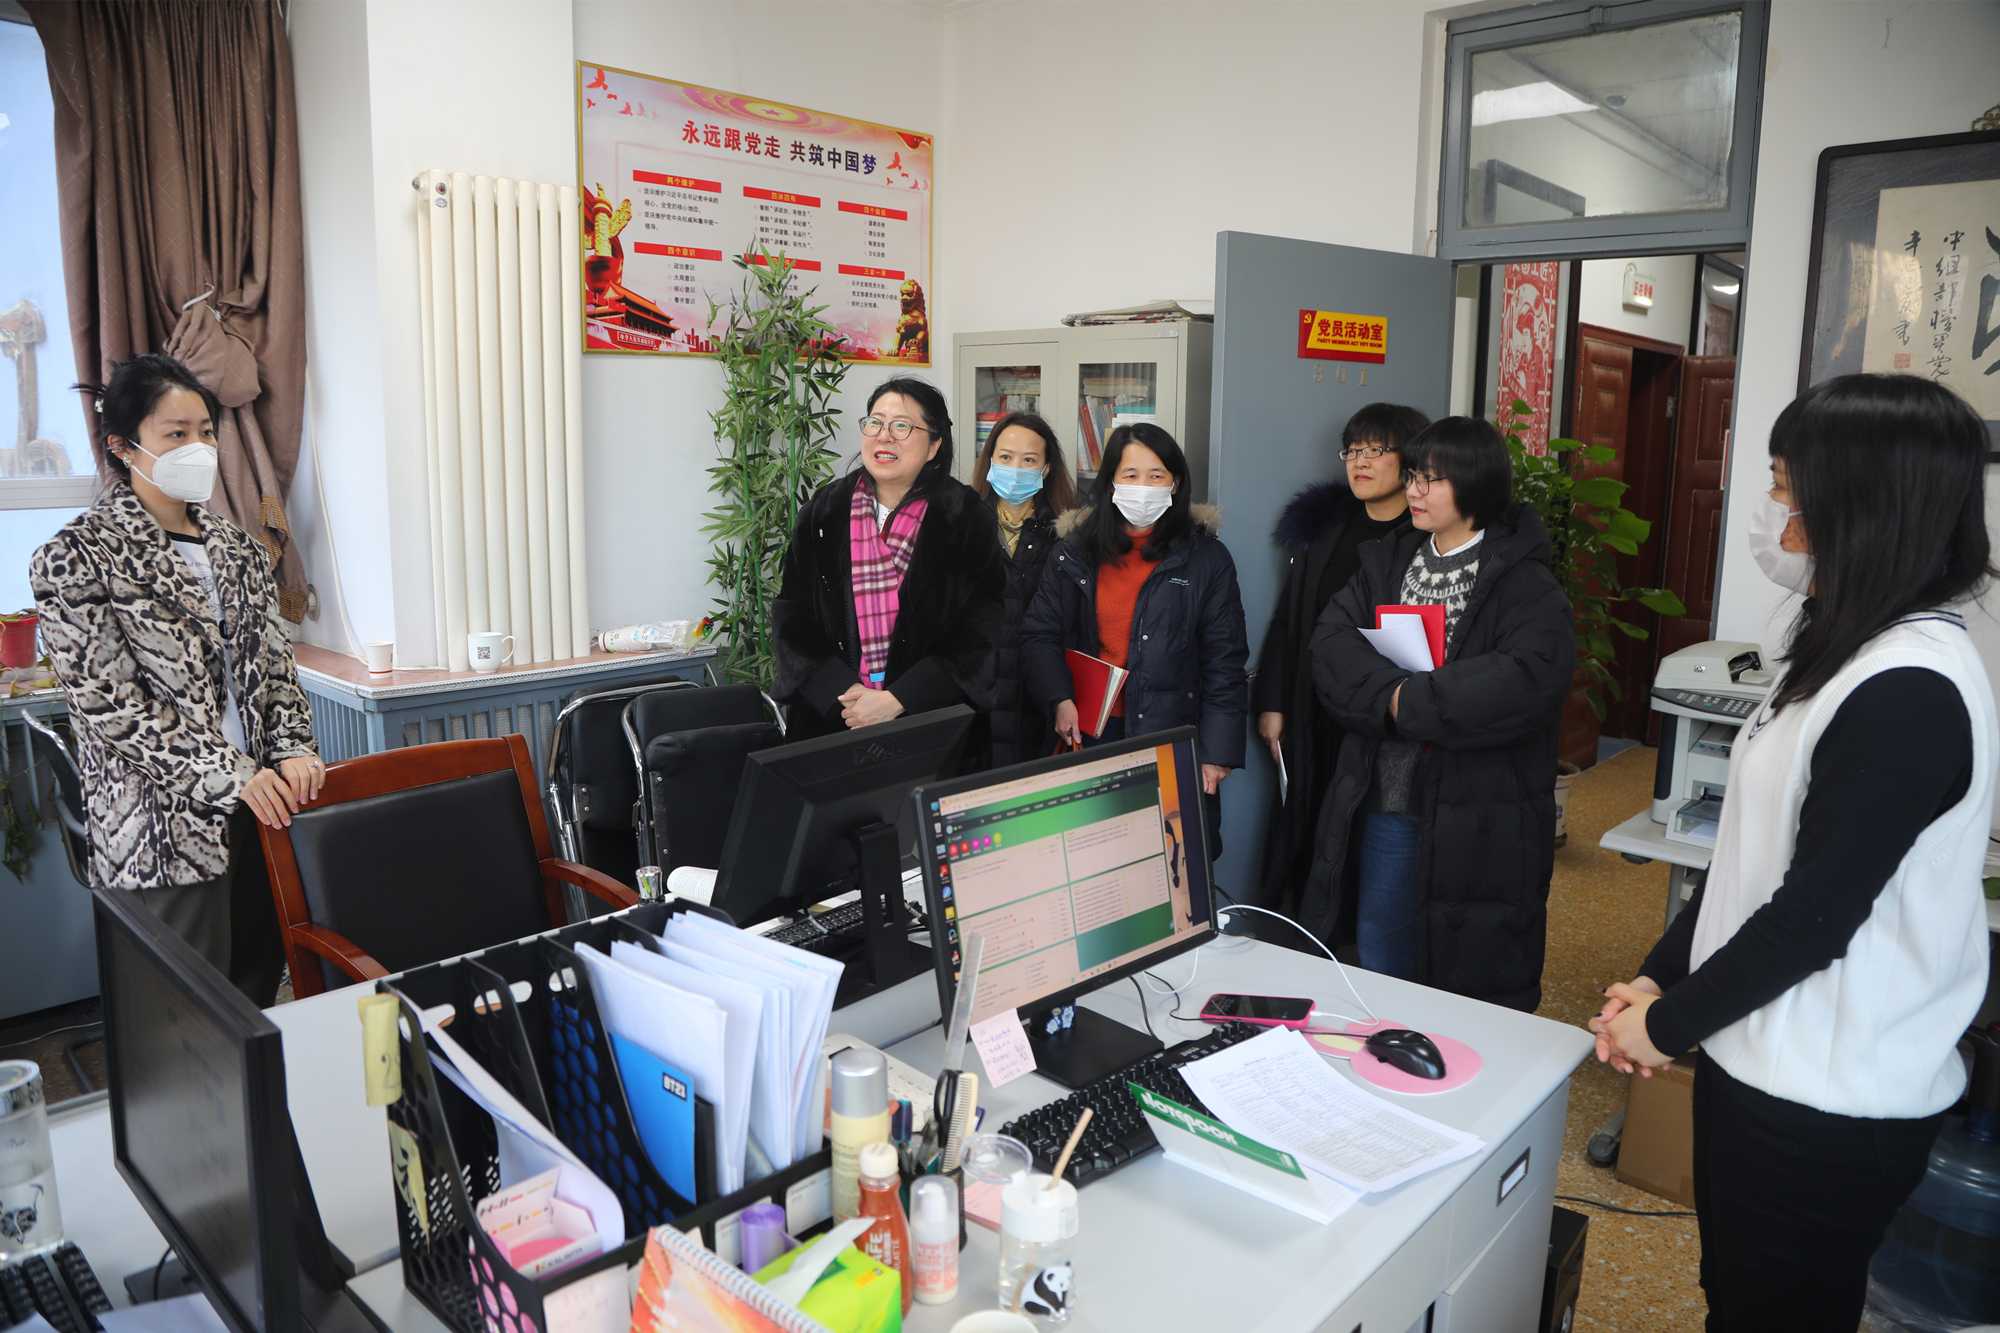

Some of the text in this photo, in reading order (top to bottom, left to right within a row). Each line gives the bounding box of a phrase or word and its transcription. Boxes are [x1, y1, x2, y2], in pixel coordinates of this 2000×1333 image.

[682, 120, 877, 175] 永远跟党走 共筑中国梦
[667, 176, 695, 187] 两个维护
[644, 188, 719, 204] 坚决维护习近平总书记党中央的
[771, 192, 796, 202] 四讲四有
[864, 206, 886, 216] 四个自信
[644, 211, 719, 226] 坚决维护党中央权威和集中统一
[668, 247, 696, 257] 四个意识
[674, 263, 695, 271] 政治意识
[864, 267, 886, 276] 三会一课
[674, 274, 695, 282] 大局意识
[674, 297, 695, 305] 看齐意识
[1318, 318, 1383, 341] 党员活动室
[1313, 363, 1366, 386] 301
[853, 738, 903, 766] DELL
[663, 1074, 687, 1100] BT21
